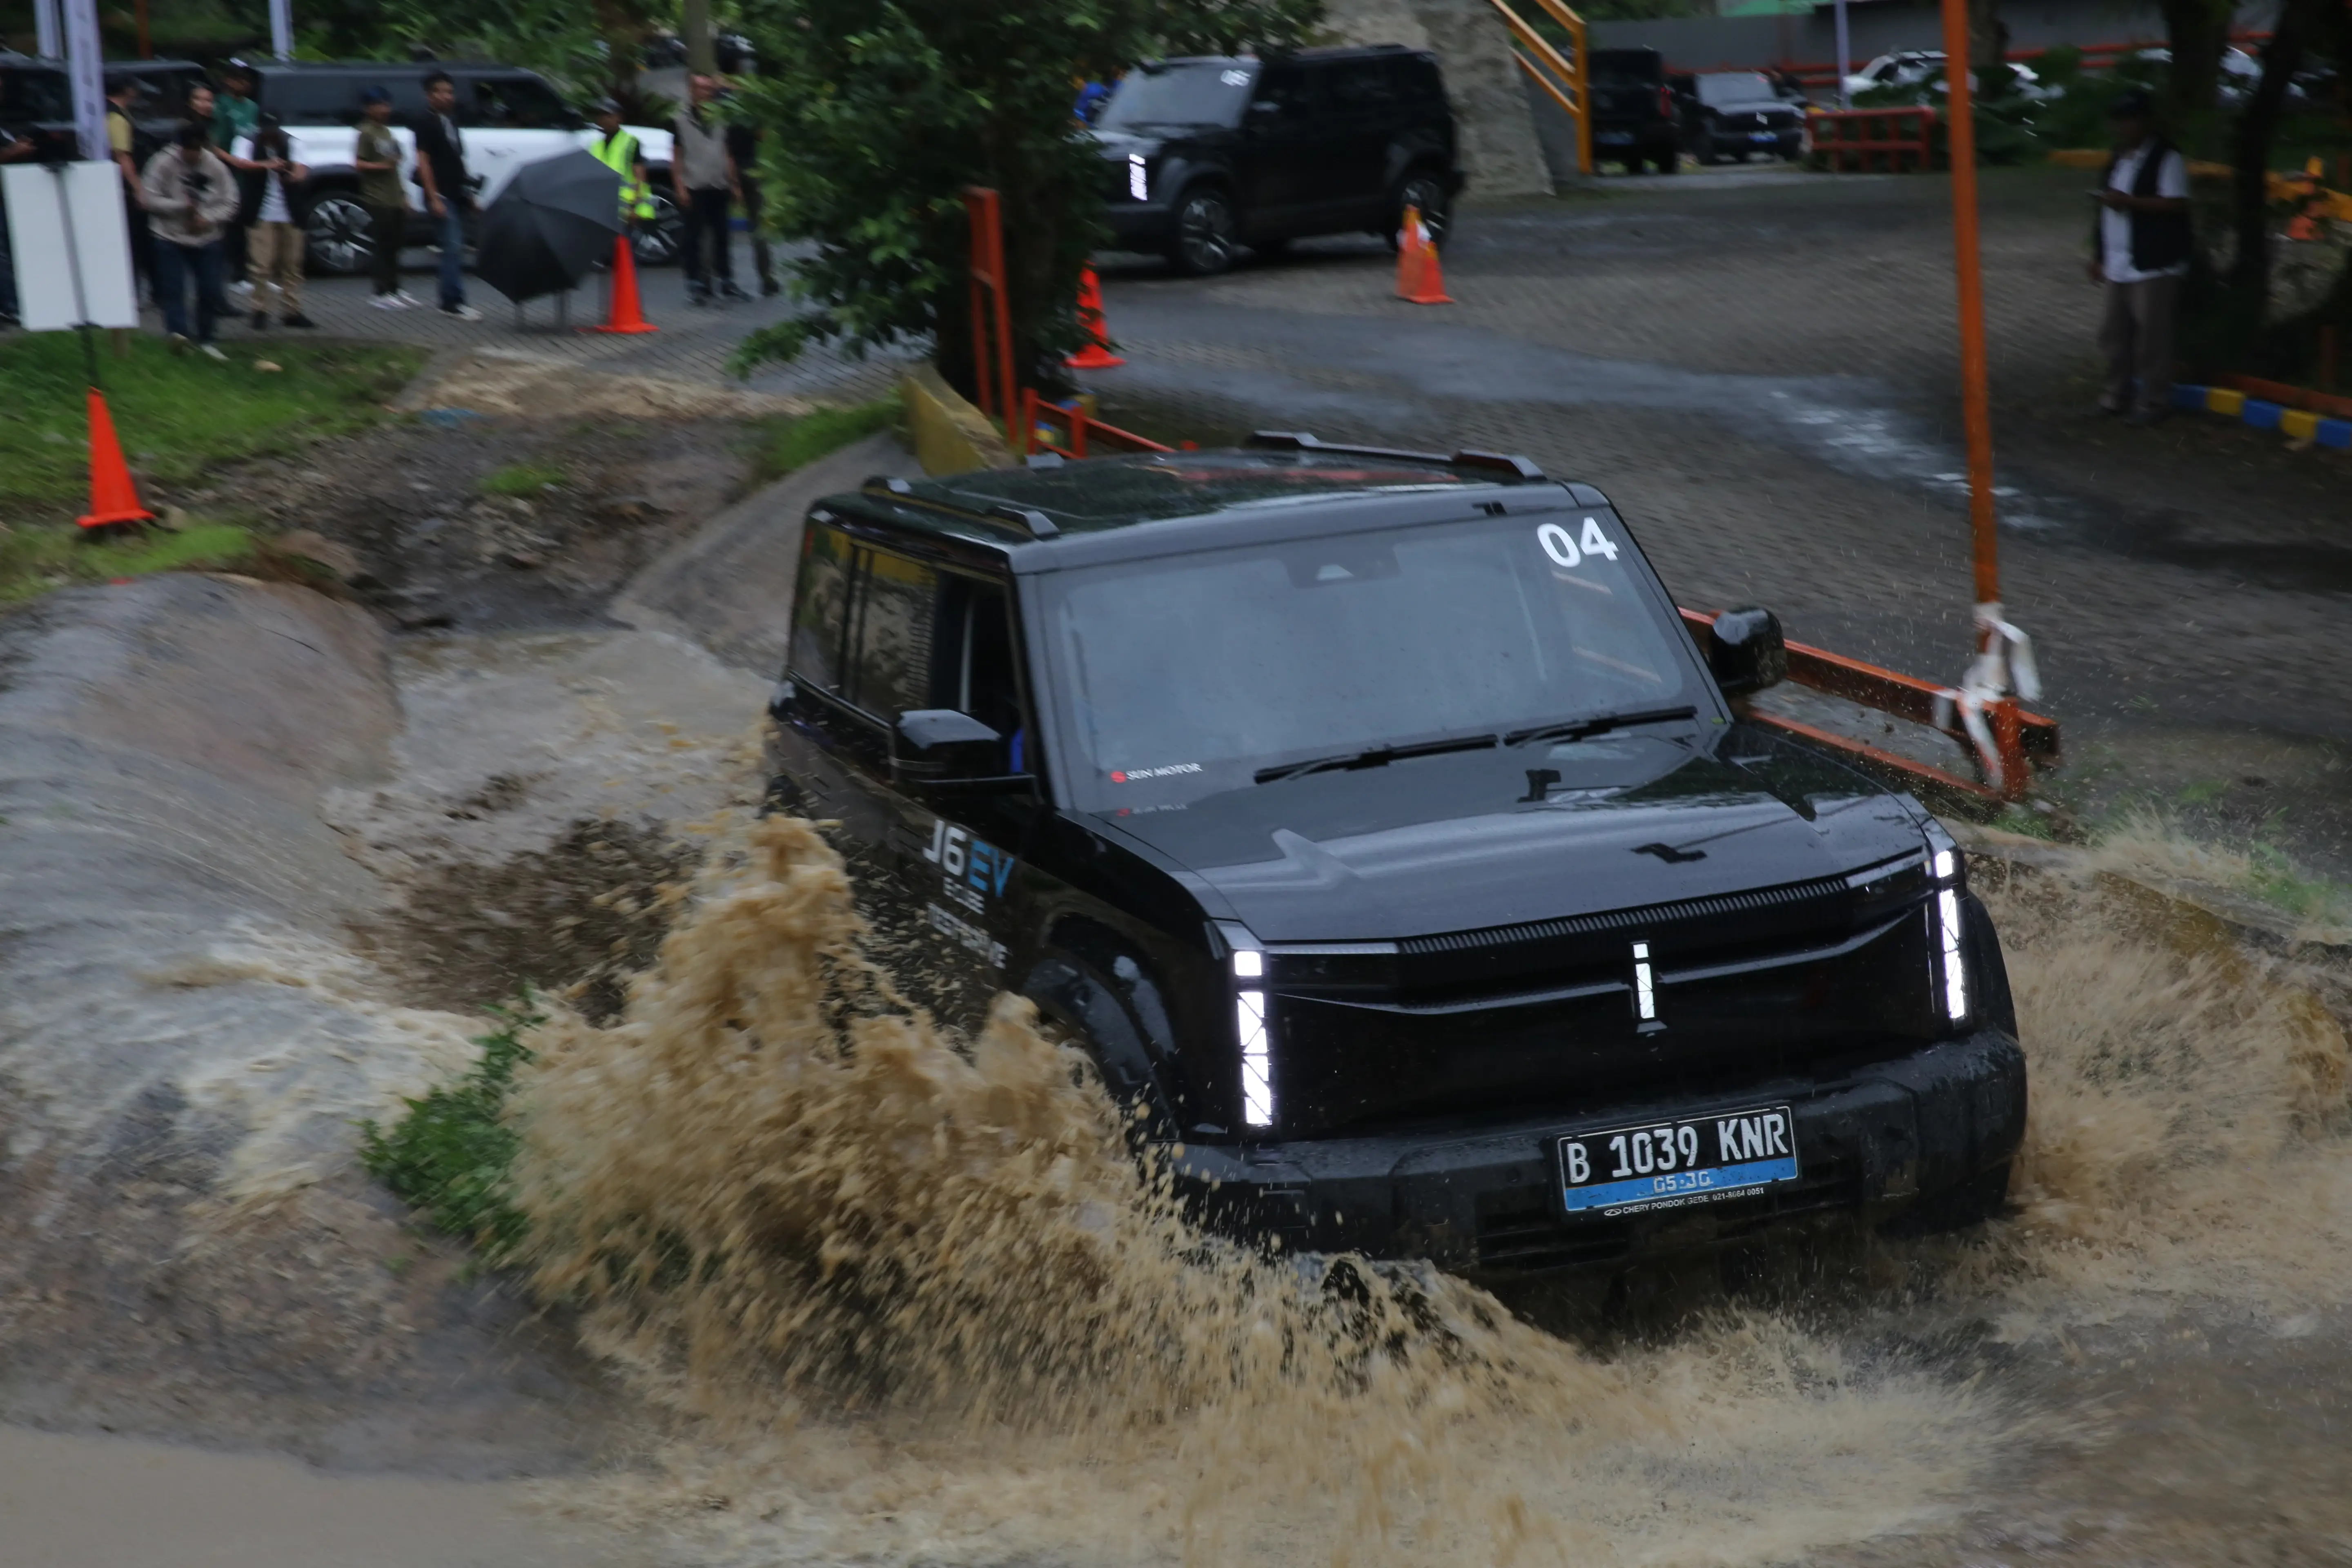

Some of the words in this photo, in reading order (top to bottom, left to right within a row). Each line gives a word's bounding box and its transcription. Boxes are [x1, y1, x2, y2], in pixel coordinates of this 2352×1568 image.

[1537, 517, 1619, 567] 04
[1126, 768, 1154, 780] SUN
[1154, 763, 1203, 776] MOTOR
[922, 819, 967, 877] J6
[969, 840, 1015, 898] EV
[1568, 1143, 1590, 1183] B
[1609, 1126, 1698, 1177] 1039
[1718, 1114, 1789, 1161] KNR
[1623, 1203, 1650, 1214] CHERY
[1651, 1198, 1686, 1209] PONDOK
[1687, 1195, 1708, 1205] GEDE
[1747, 1188, 1764, 1196] 0051
